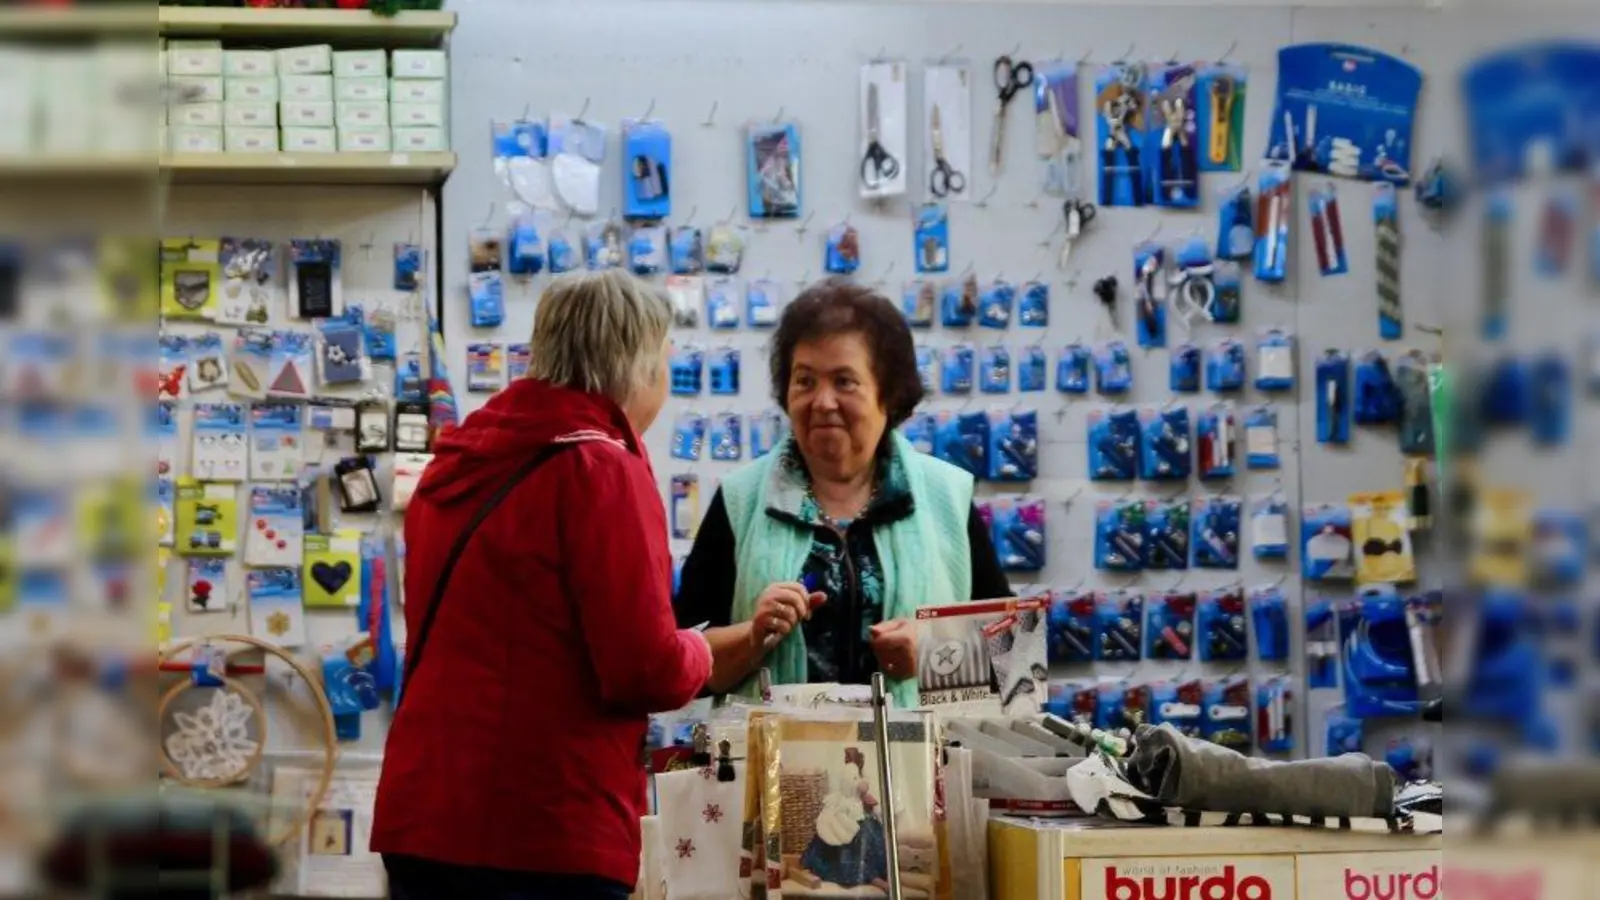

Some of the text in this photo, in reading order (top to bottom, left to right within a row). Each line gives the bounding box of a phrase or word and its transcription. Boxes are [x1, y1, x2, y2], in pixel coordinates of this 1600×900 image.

[920, 686, 989, 706] Black & White
[1105, 865, 1272, 900] burda
[1123, 864, 1218, 875] world of fashion
[1344, 865, 1442, 900] burd
